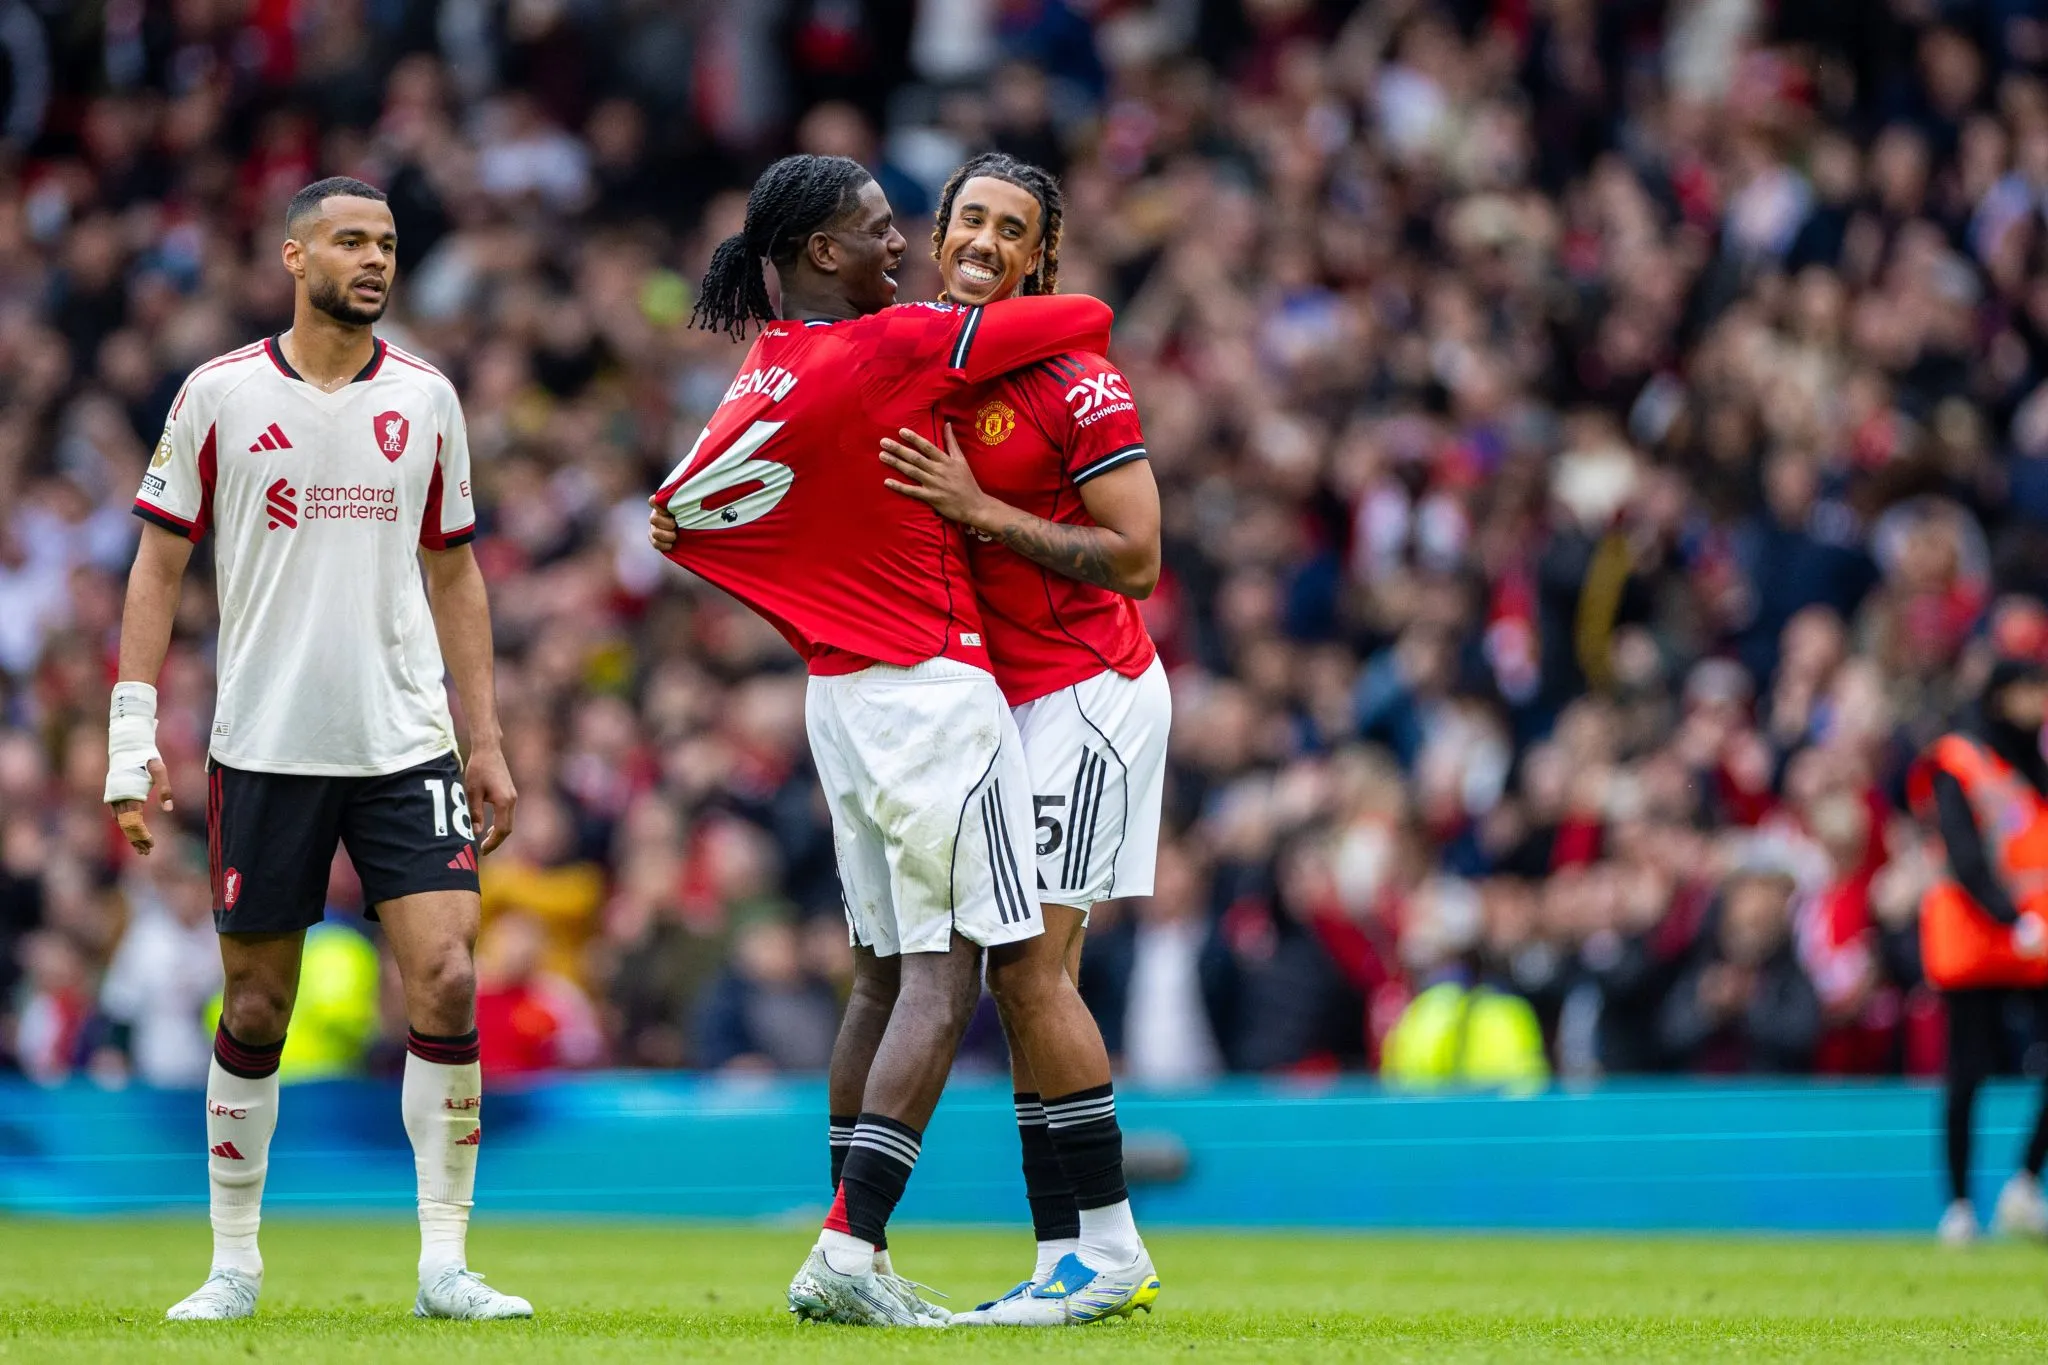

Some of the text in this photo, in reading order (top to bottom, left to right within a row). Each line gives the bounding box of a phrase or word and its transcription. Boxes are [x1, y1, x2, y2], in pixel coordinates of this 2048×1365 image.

[1065, 372, 1131, 419] DXC
[305, 484, 395, 503] standard
[304, 502, 398, 522] chartered
[424, 779, 476, 841] 18
[208, 1100, 247, 1120] LFC
